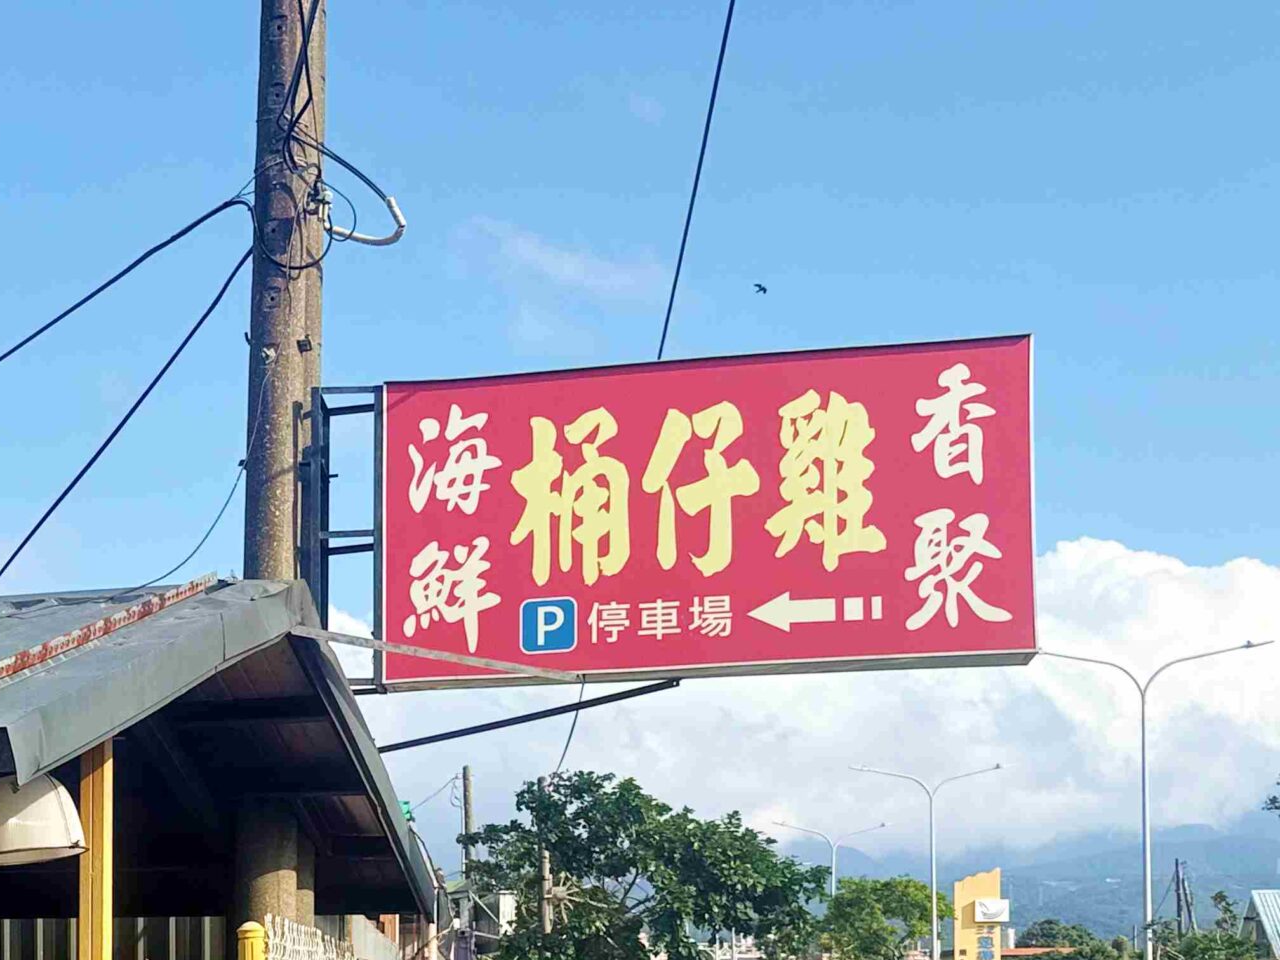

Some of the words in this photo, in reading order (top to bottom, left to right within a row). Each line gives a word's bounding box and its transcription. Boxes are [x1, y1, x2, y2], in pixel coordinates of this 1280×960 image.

[402, 402, 503, 654] 海鮮
[509, 387, 888, 587] 桶仔雞
[904, 361, 1013, 632] 香聚
[586, 594, 734, 645] 停車場
